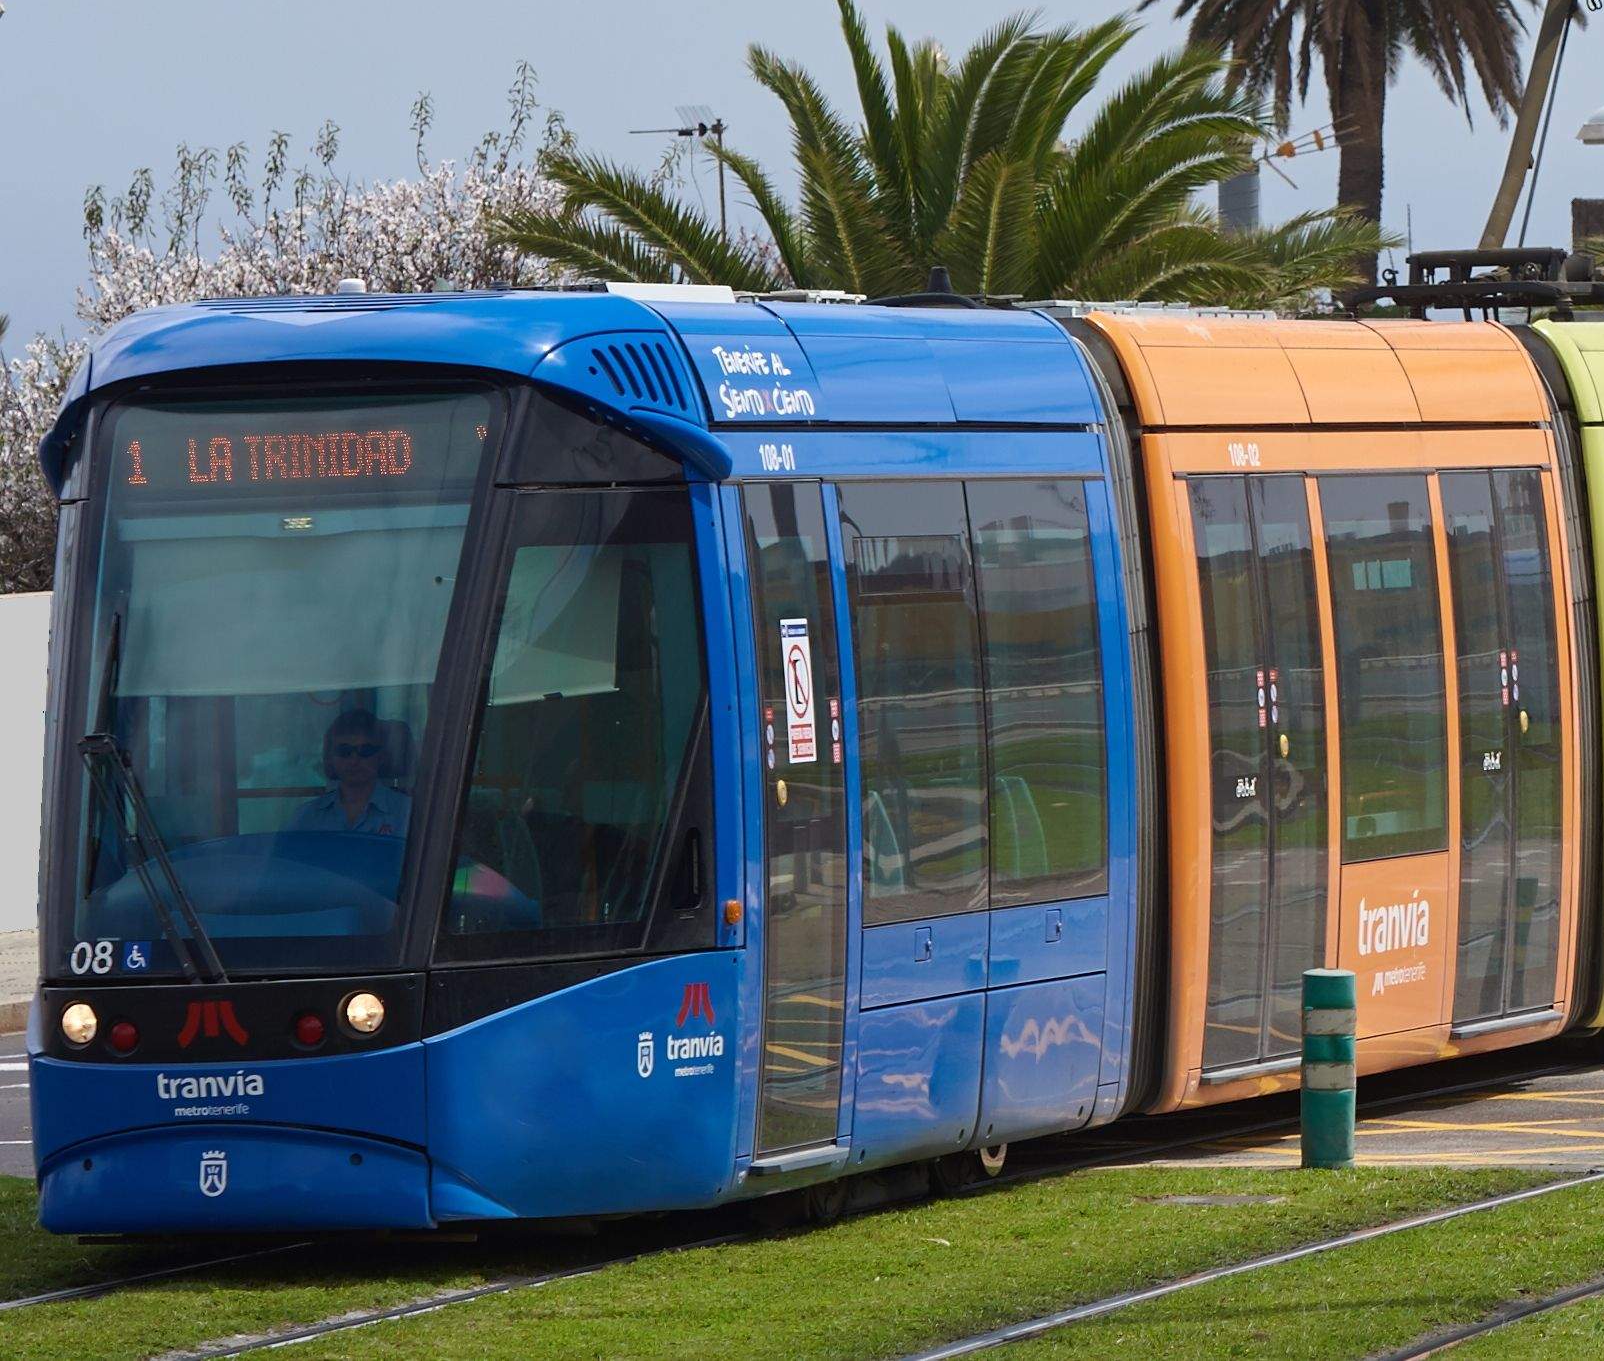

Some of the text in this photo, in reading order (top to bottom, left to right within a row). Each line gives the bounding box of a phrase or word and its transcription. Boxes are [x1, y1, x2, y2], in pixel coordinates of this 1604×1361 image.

[127, 430, 413, 485] 1 LA TRINIDAD
[759, 444, 796, 471] 108-01
[1358, 889, 1430, 956] tranvía
[70, 941, 114, 975] 08
[667, 1030, 724, 1061] tranvía
[157, 1070, 265, 1099] tranvía
[174, 1103, 250, 1117] metrotenerife
